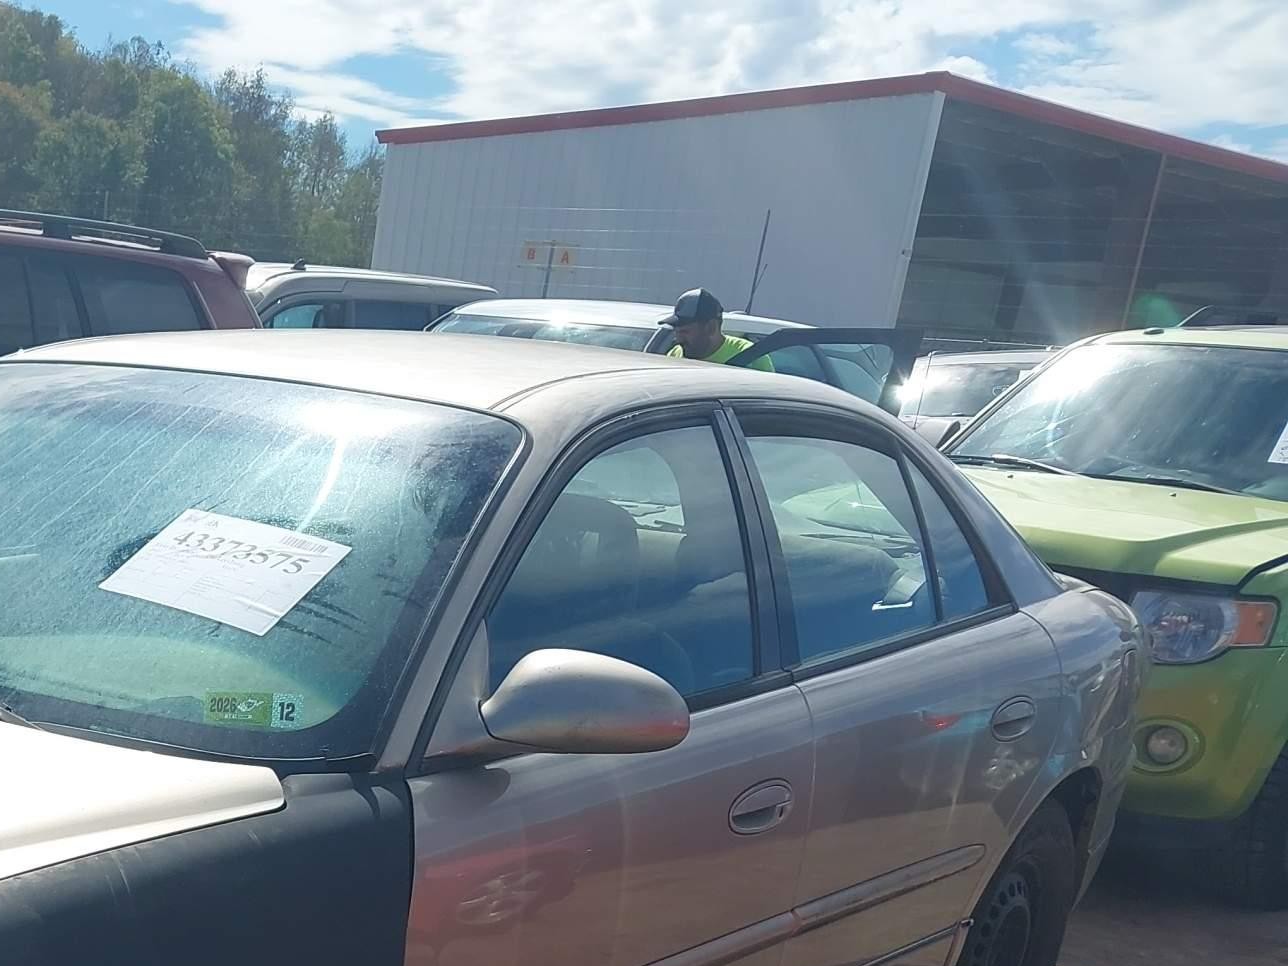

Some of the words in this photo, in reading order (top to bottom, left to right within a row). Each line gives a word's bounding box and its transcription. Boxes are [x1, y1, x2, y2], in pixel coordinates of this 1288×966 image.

[560, 250, 569, 264] A
[172, 531, 311, 574] 43373575
[278, 702, 296, 722] 12
